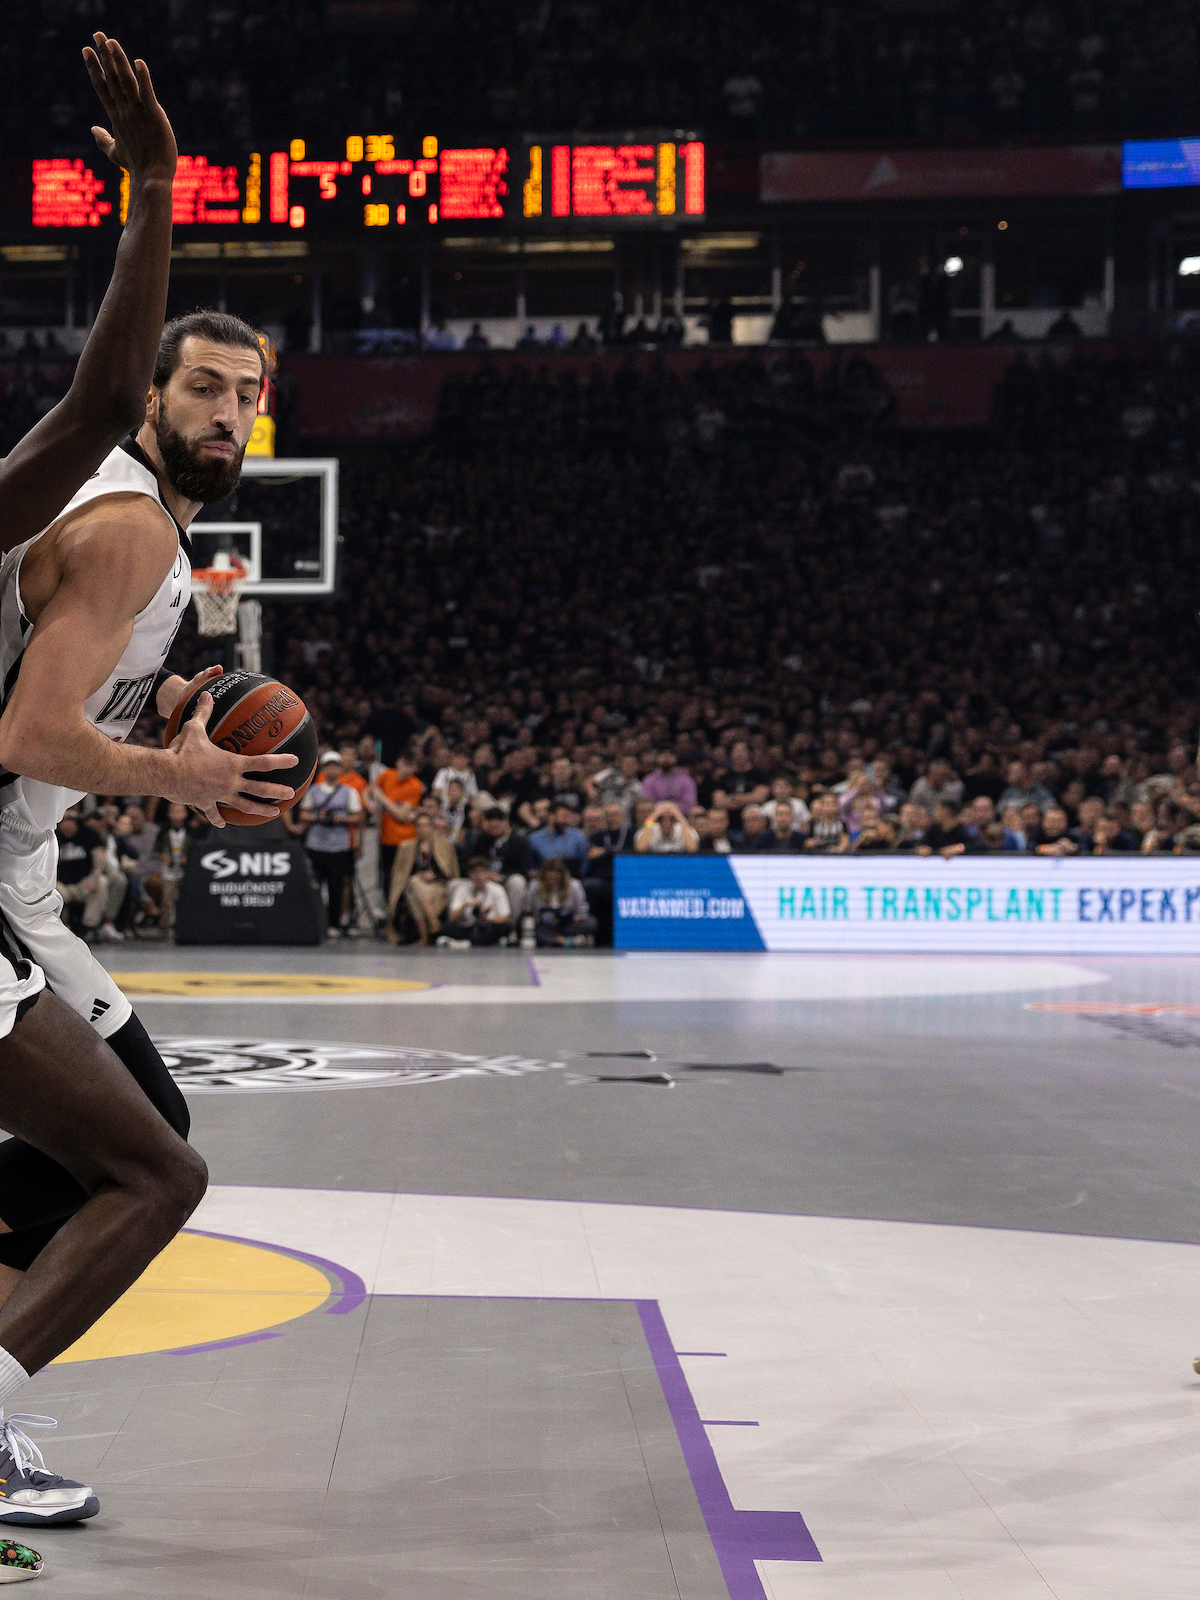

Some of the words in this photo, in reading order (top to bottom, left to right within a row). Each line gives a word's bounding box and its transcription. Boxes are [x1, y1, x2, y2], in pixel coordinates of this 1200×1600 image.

[240, 851, 292, 876] NIS
[220, 895, 240, 907] NA
[779, 886, 849, 921] HAIR
[862, 886, 1064, 922] TRANSPLANT
